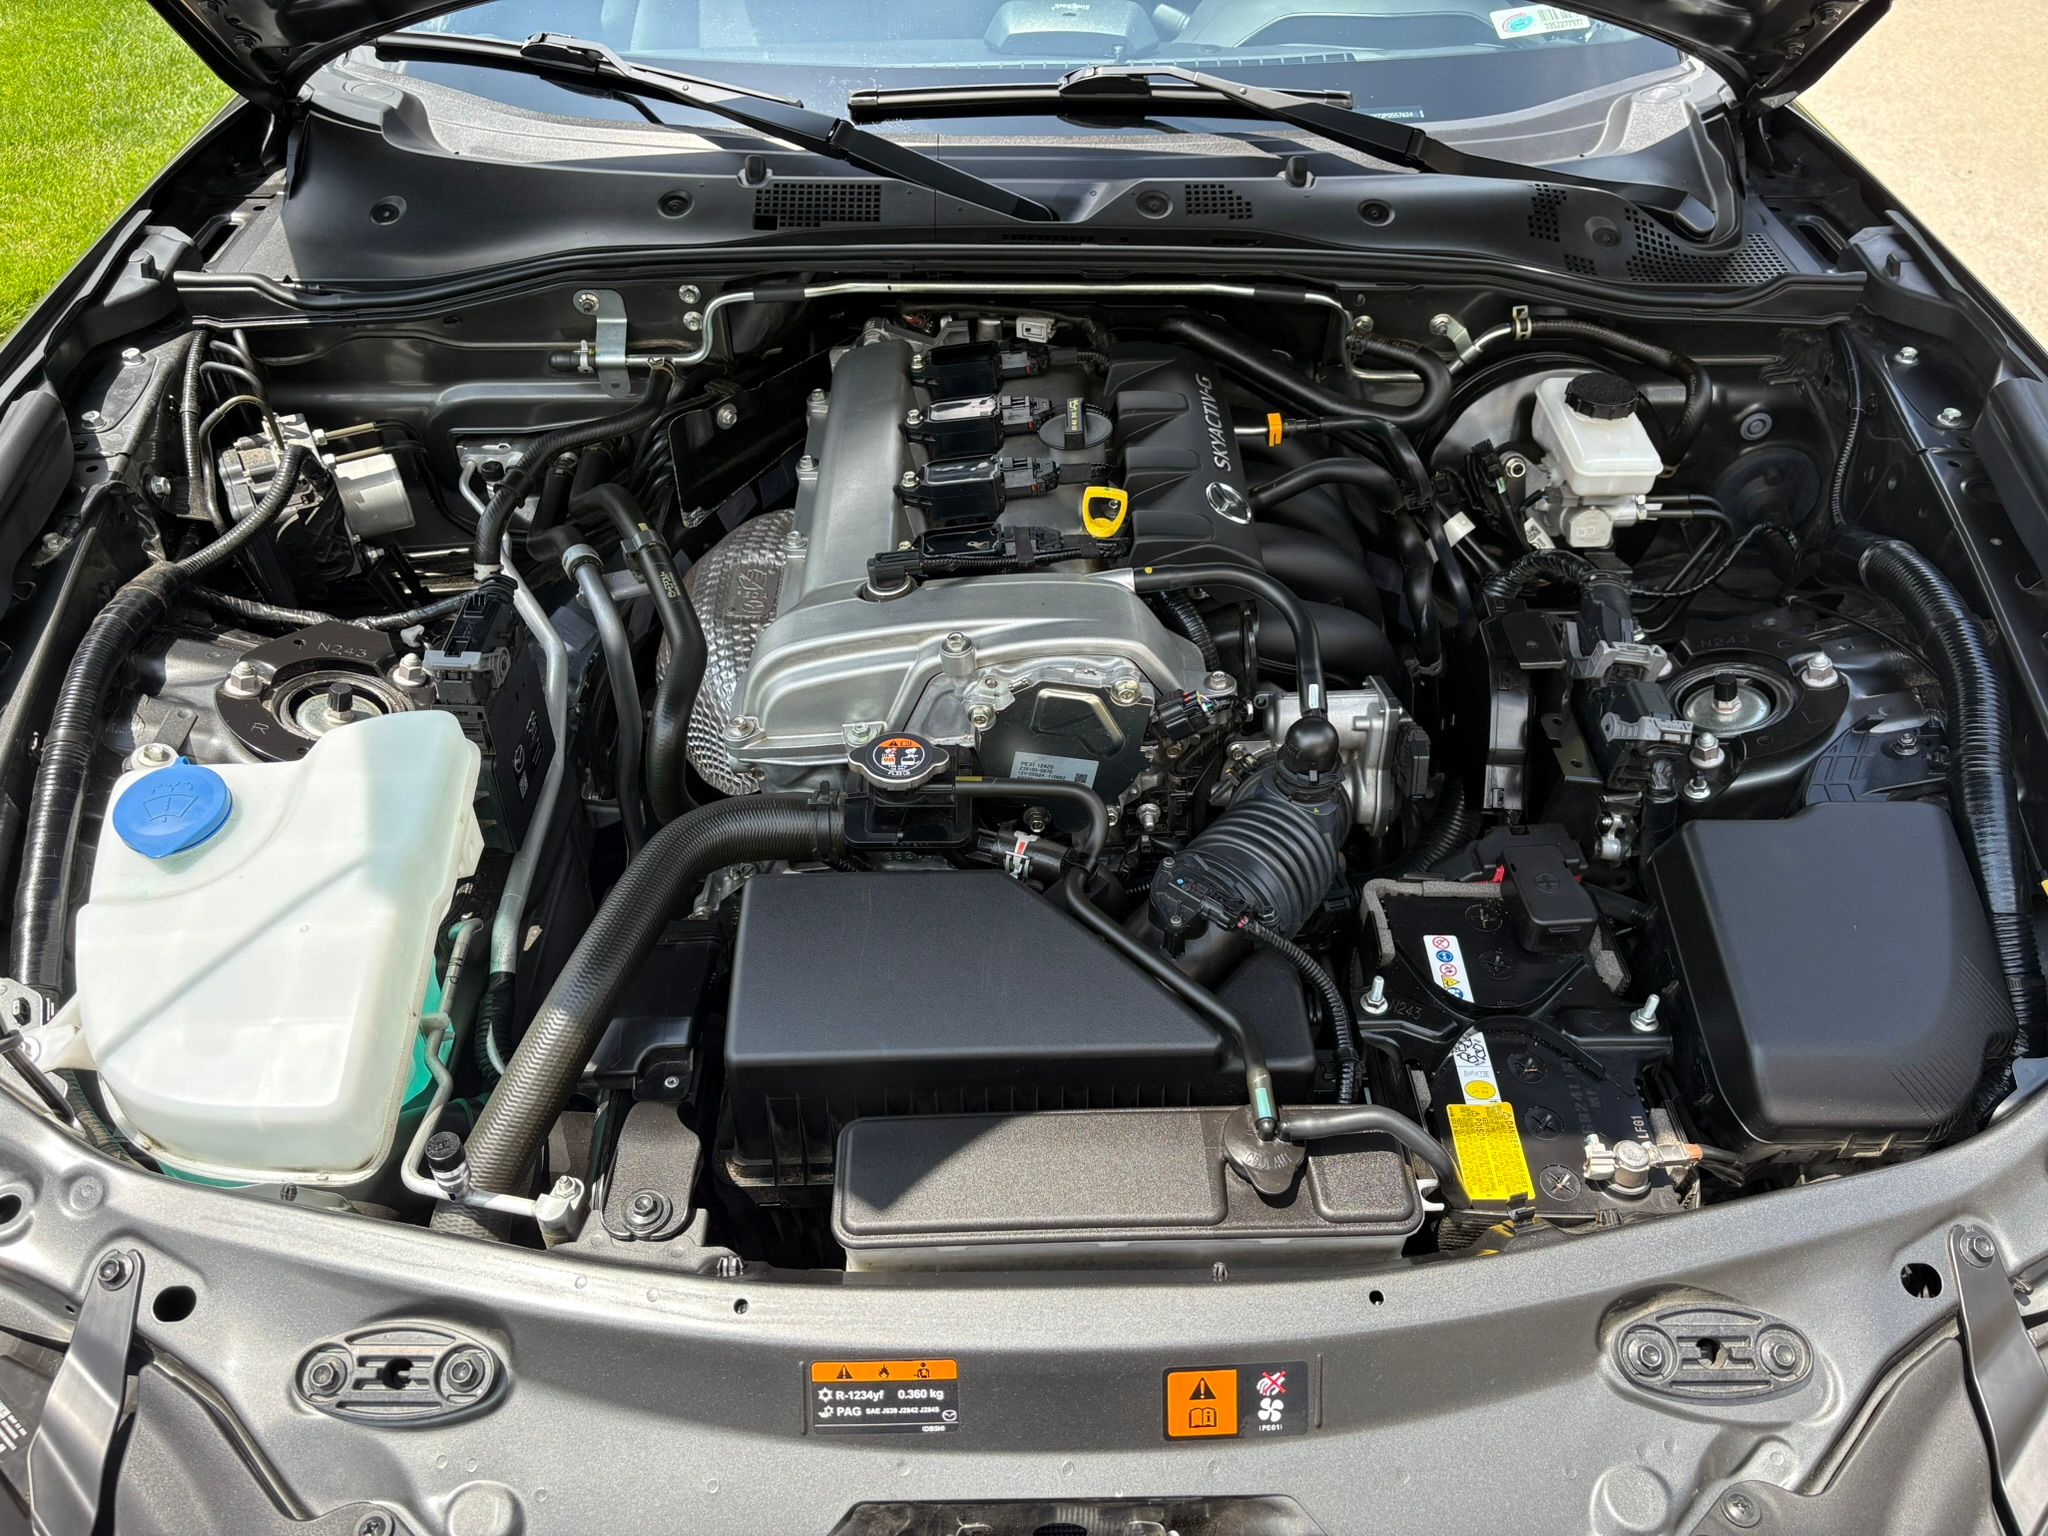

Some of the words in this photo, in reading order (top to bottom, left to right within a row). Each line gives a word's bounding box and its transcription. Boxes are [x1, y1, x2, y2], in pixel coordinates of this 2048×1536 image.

[1195, 373, 1231, 472] SKYACTIV-G
[317, 641, 367, 657] N243
[250, 722, 270, 735] R
[1473, 1117, 1486, 1141] POISON
[1505, 1120, 1519, 1150] DANGER
[836, 1390, 884, 1401] R-1234yf
[898, 1389, 927, 1399] 0.360
[930, 1389, 944, 1400] kg
[837, 1407, 862, 1416] PAG
